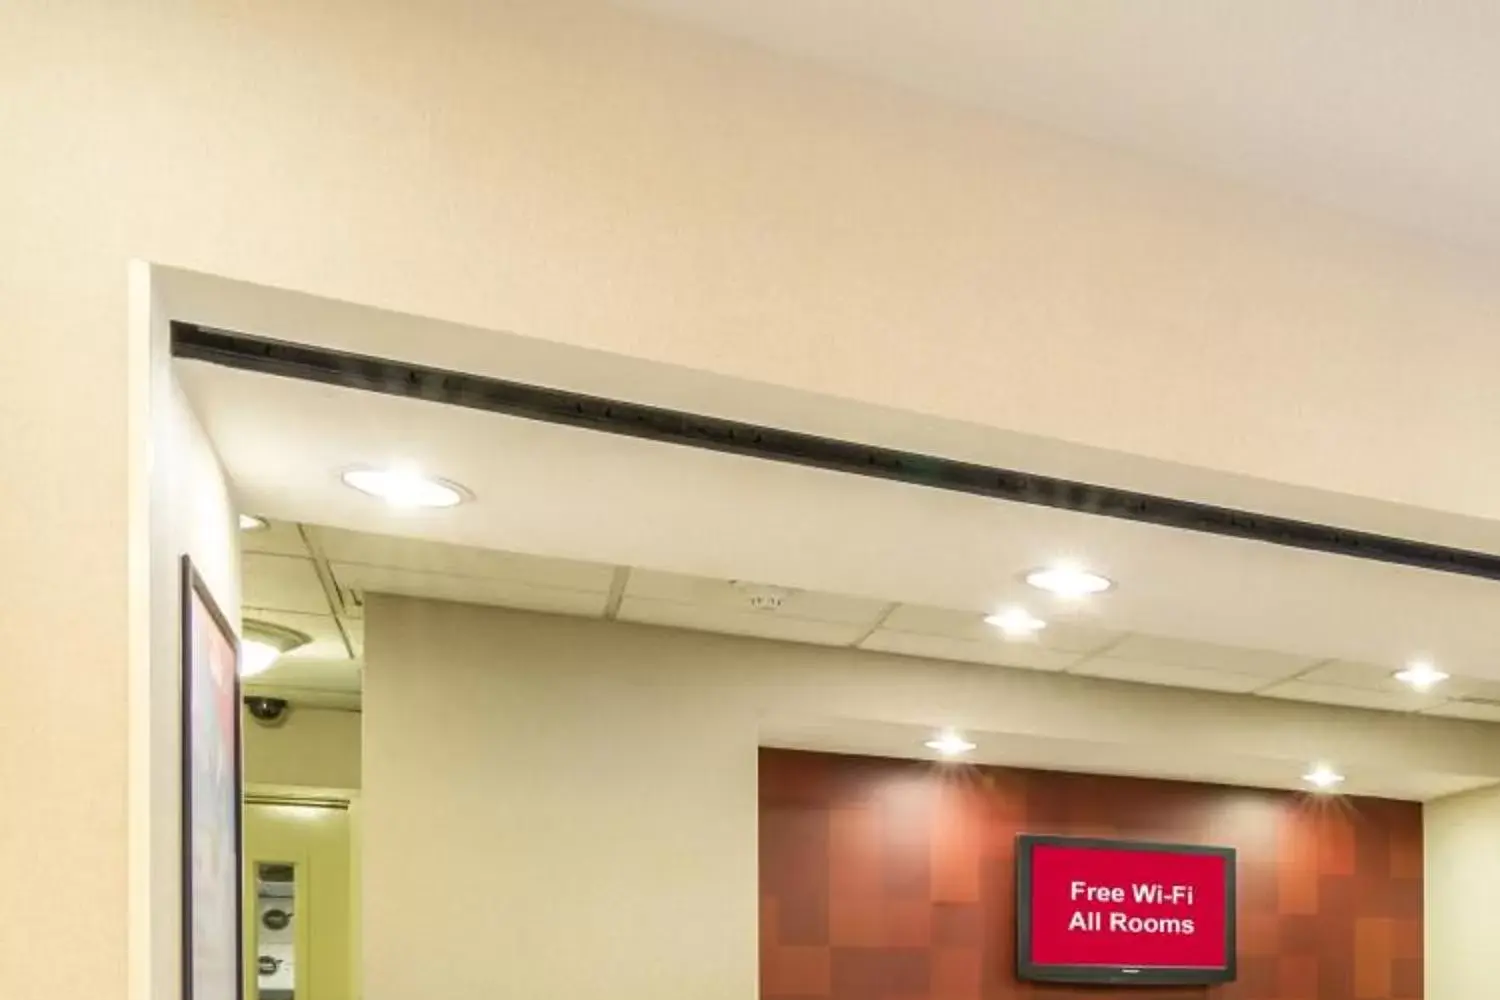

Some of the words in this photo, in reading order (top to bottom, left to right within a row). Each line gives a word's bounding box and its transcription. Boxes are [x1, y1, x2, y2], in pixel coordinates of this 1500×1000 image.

[1070, 881, 1125, 903] Free
[1132, 884, 1194, 905] Wi-Fi
[1068, 911, 1101, 932] All
[1109, 912, 1195, 935] Rooms
